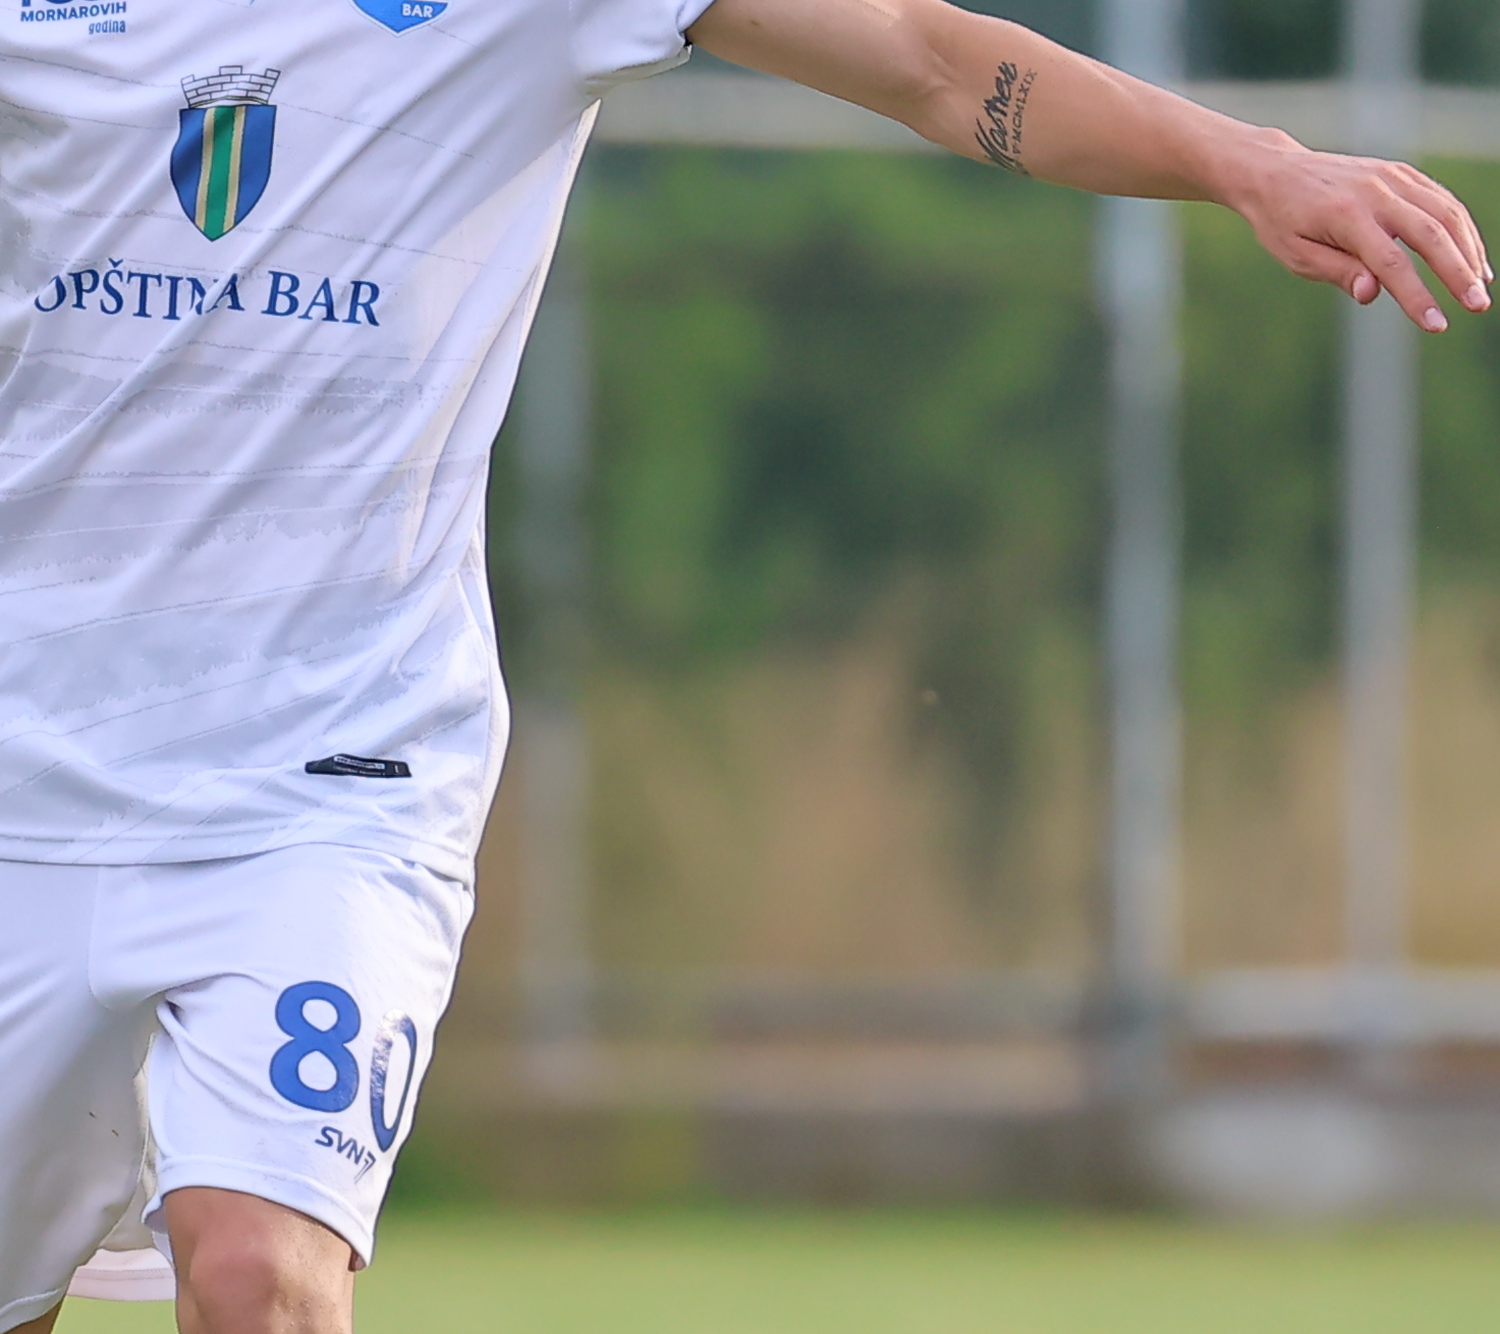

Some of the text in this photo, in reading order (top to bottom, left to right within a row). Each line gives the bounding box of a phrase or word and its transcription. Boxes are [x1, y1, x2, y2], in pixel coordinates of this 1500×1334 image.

[20, 1, 127, 22] MORNAROVIH
[402, 3, 434, 18] BAR
[88, 19, 126, 35] godina
[261, 270, 381, 327] BAR
[269, 980, 417, 1153] 80
